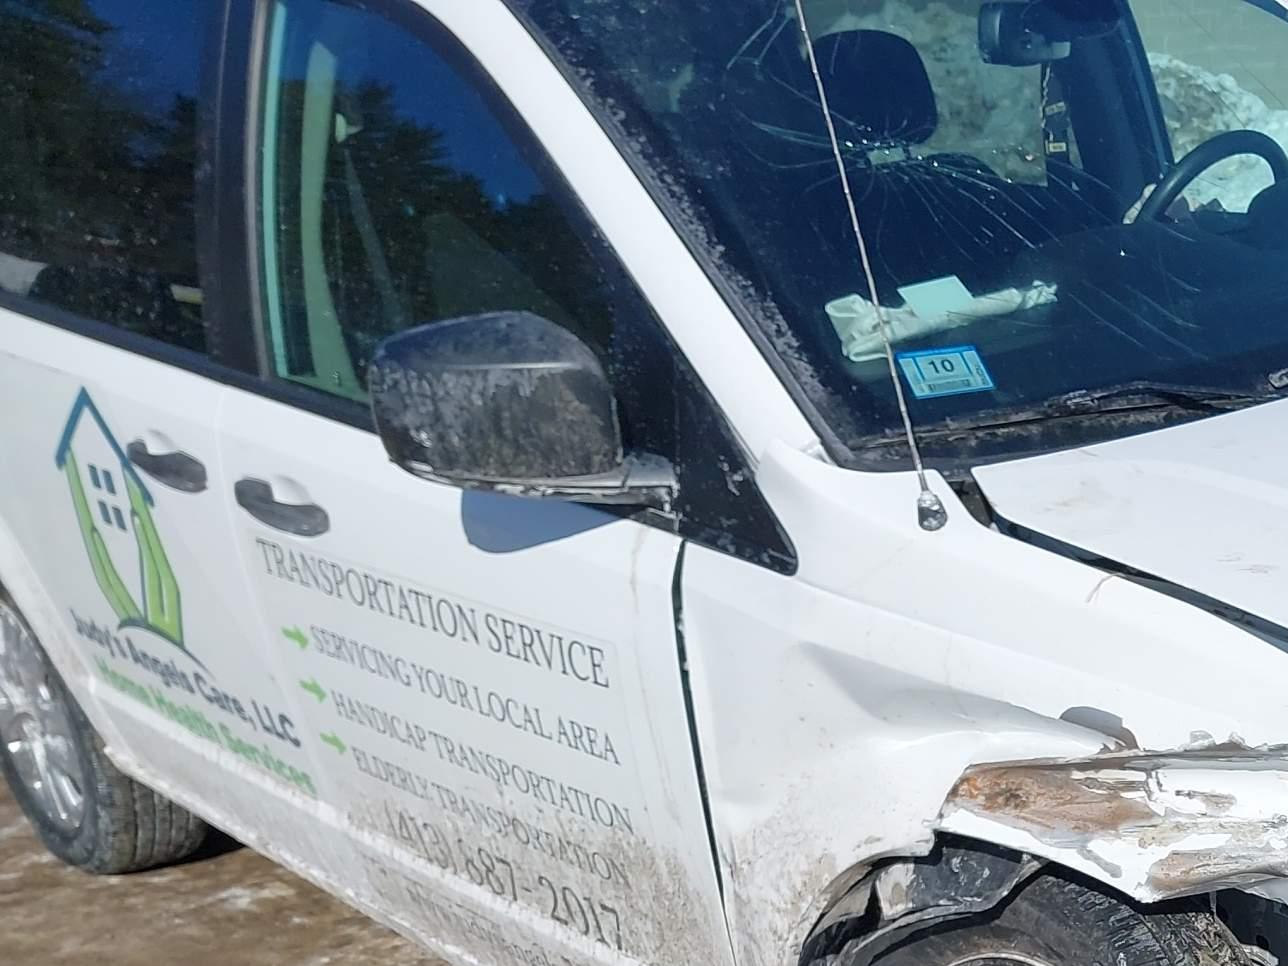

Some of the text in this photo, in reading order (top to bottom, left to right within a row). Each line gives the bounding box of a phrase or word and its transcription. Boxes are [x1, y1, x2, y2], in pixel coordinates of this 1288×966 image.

[928, 358, 955, 374] 10
[255, 538, 610, 688] TRANSPORTATION SERVICE
[193, 672, 259, 732] Care,
[251, 699, 301, 748] LLC
[309, 625, 621, 766] SERVICING YOUR LOCAL AREA
[330, 690, 634, 835] HANDICAP TRANSPORTATION
[351, 746, 632, 889] ELDERLY TRANSPORTATION
